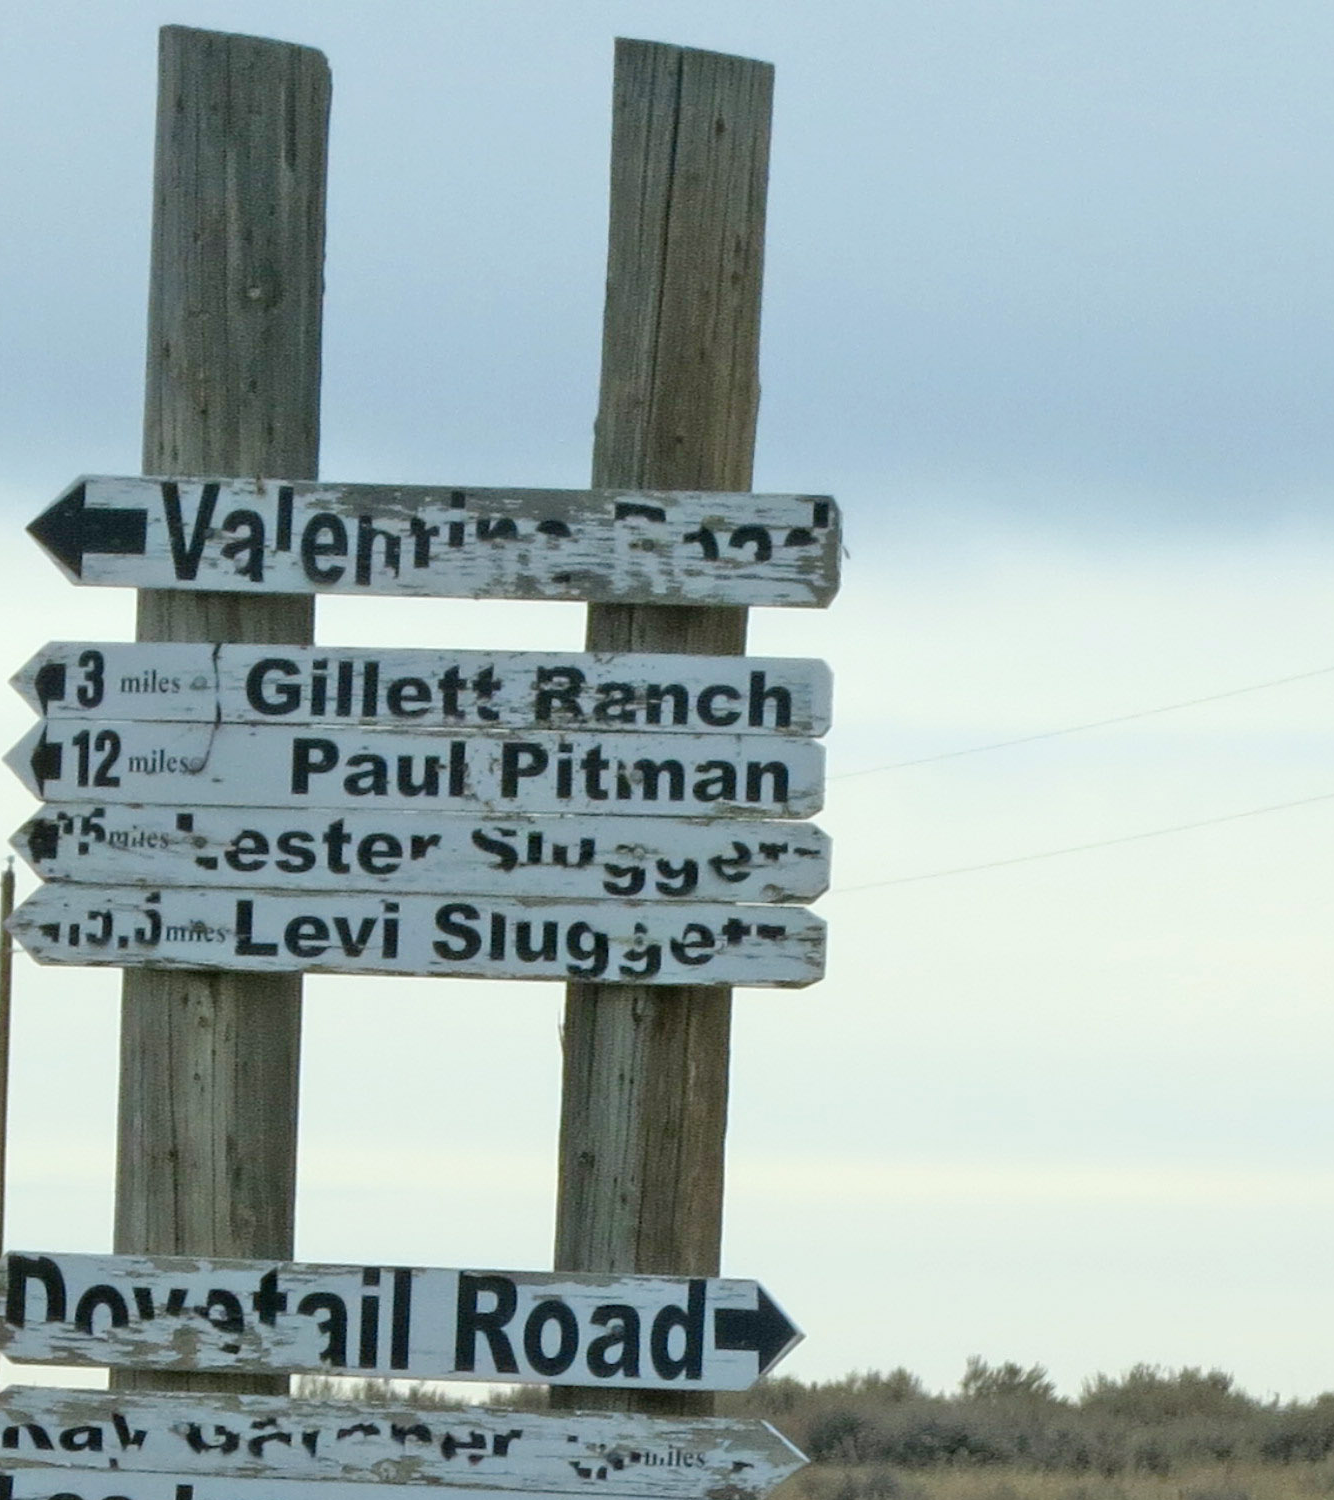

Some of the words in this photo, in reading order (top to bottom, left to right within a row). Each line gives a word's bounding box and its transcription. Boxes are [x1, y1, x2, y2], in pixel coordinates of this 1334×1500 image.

[76, 649, 105, 709] 3
[120, 670, 181, 696] miles
[246, 657, 504, 718] Gillett
[533, 664, 793, 727] Ranch
[72, 728, 122, 788] 12
[128, 750, 190, 777] miles
[291, 738, 468, 796] Paul
[501, 741, 790, 803] Pitman
[234, 900, 401, 959] Levi
[432, 903, 787, 980] Slugge
[454, 1271, 709, 1381] Road
